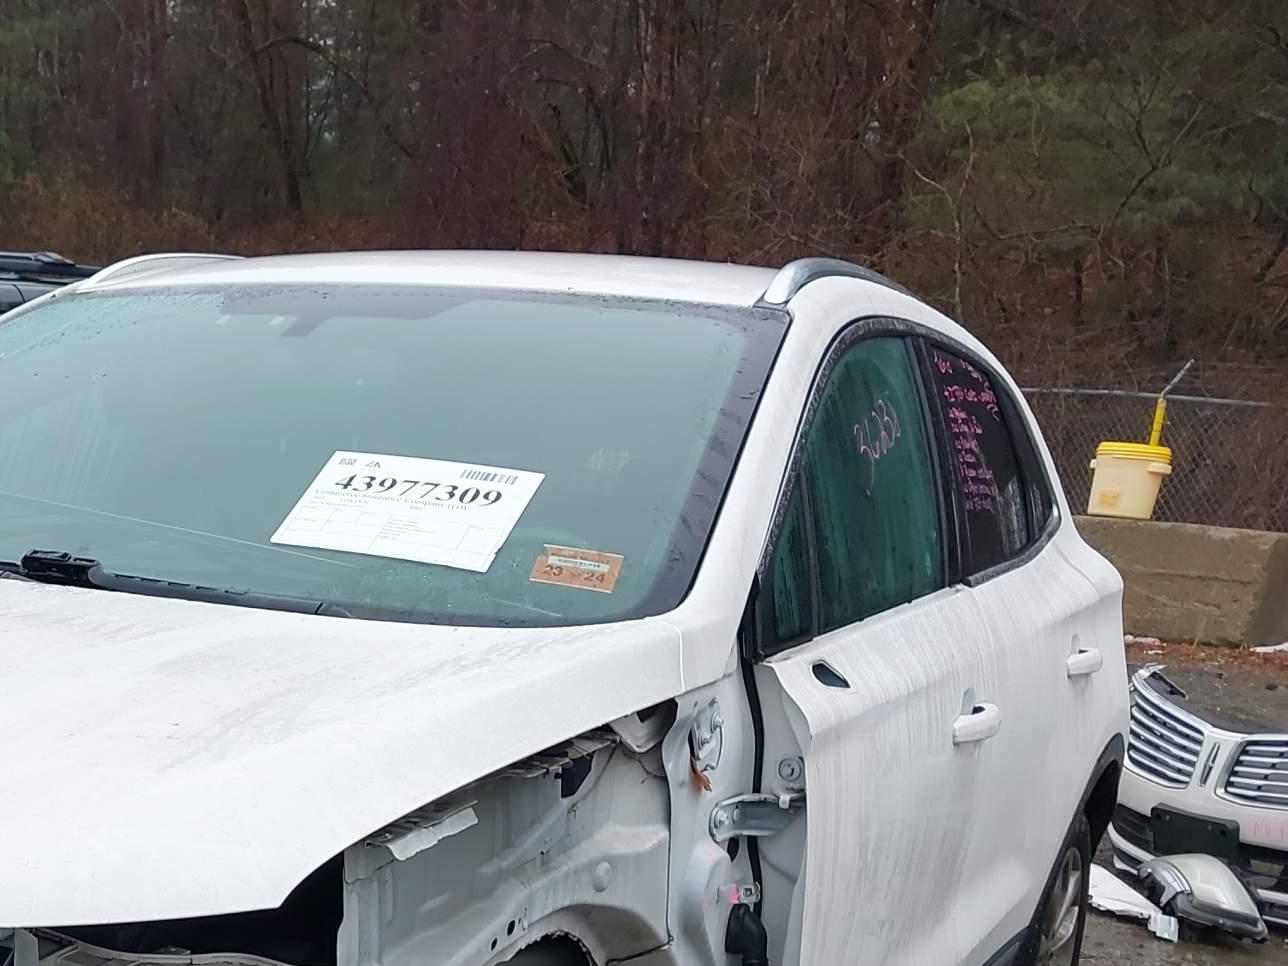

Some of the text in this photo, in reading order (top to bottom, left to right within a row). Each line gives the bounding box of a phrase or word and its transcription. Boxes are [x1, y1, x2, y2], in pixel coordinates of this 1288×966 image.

[335, 474, 503, 507] 43977309
[542, 564, 606, 584] 23 24
